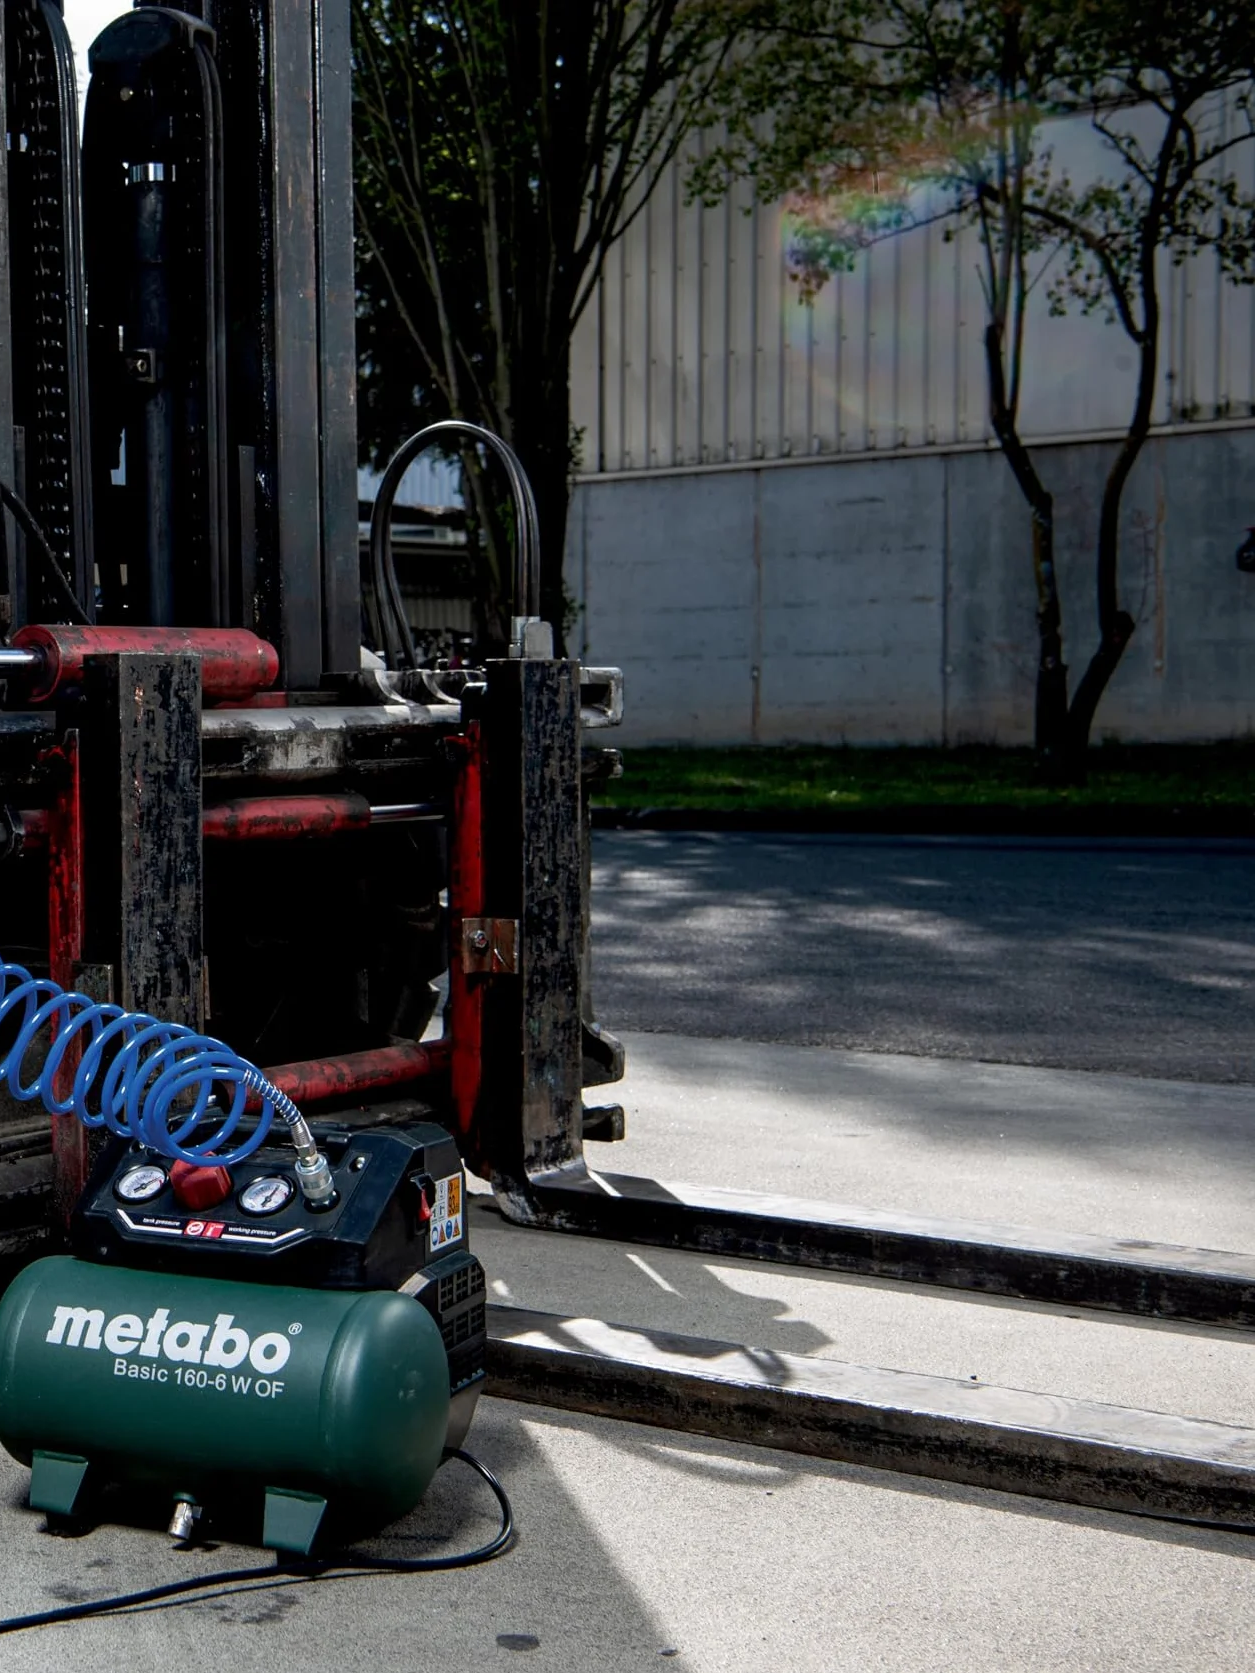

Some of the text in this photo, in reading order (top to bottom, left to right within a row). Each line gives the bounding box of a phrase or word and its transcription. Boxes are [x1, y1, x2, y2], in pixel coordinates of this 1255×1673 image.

[228, 1226, 277, 1237] working pressure
[113, 1358, 285, 1399] Basic 160-6 W OF
